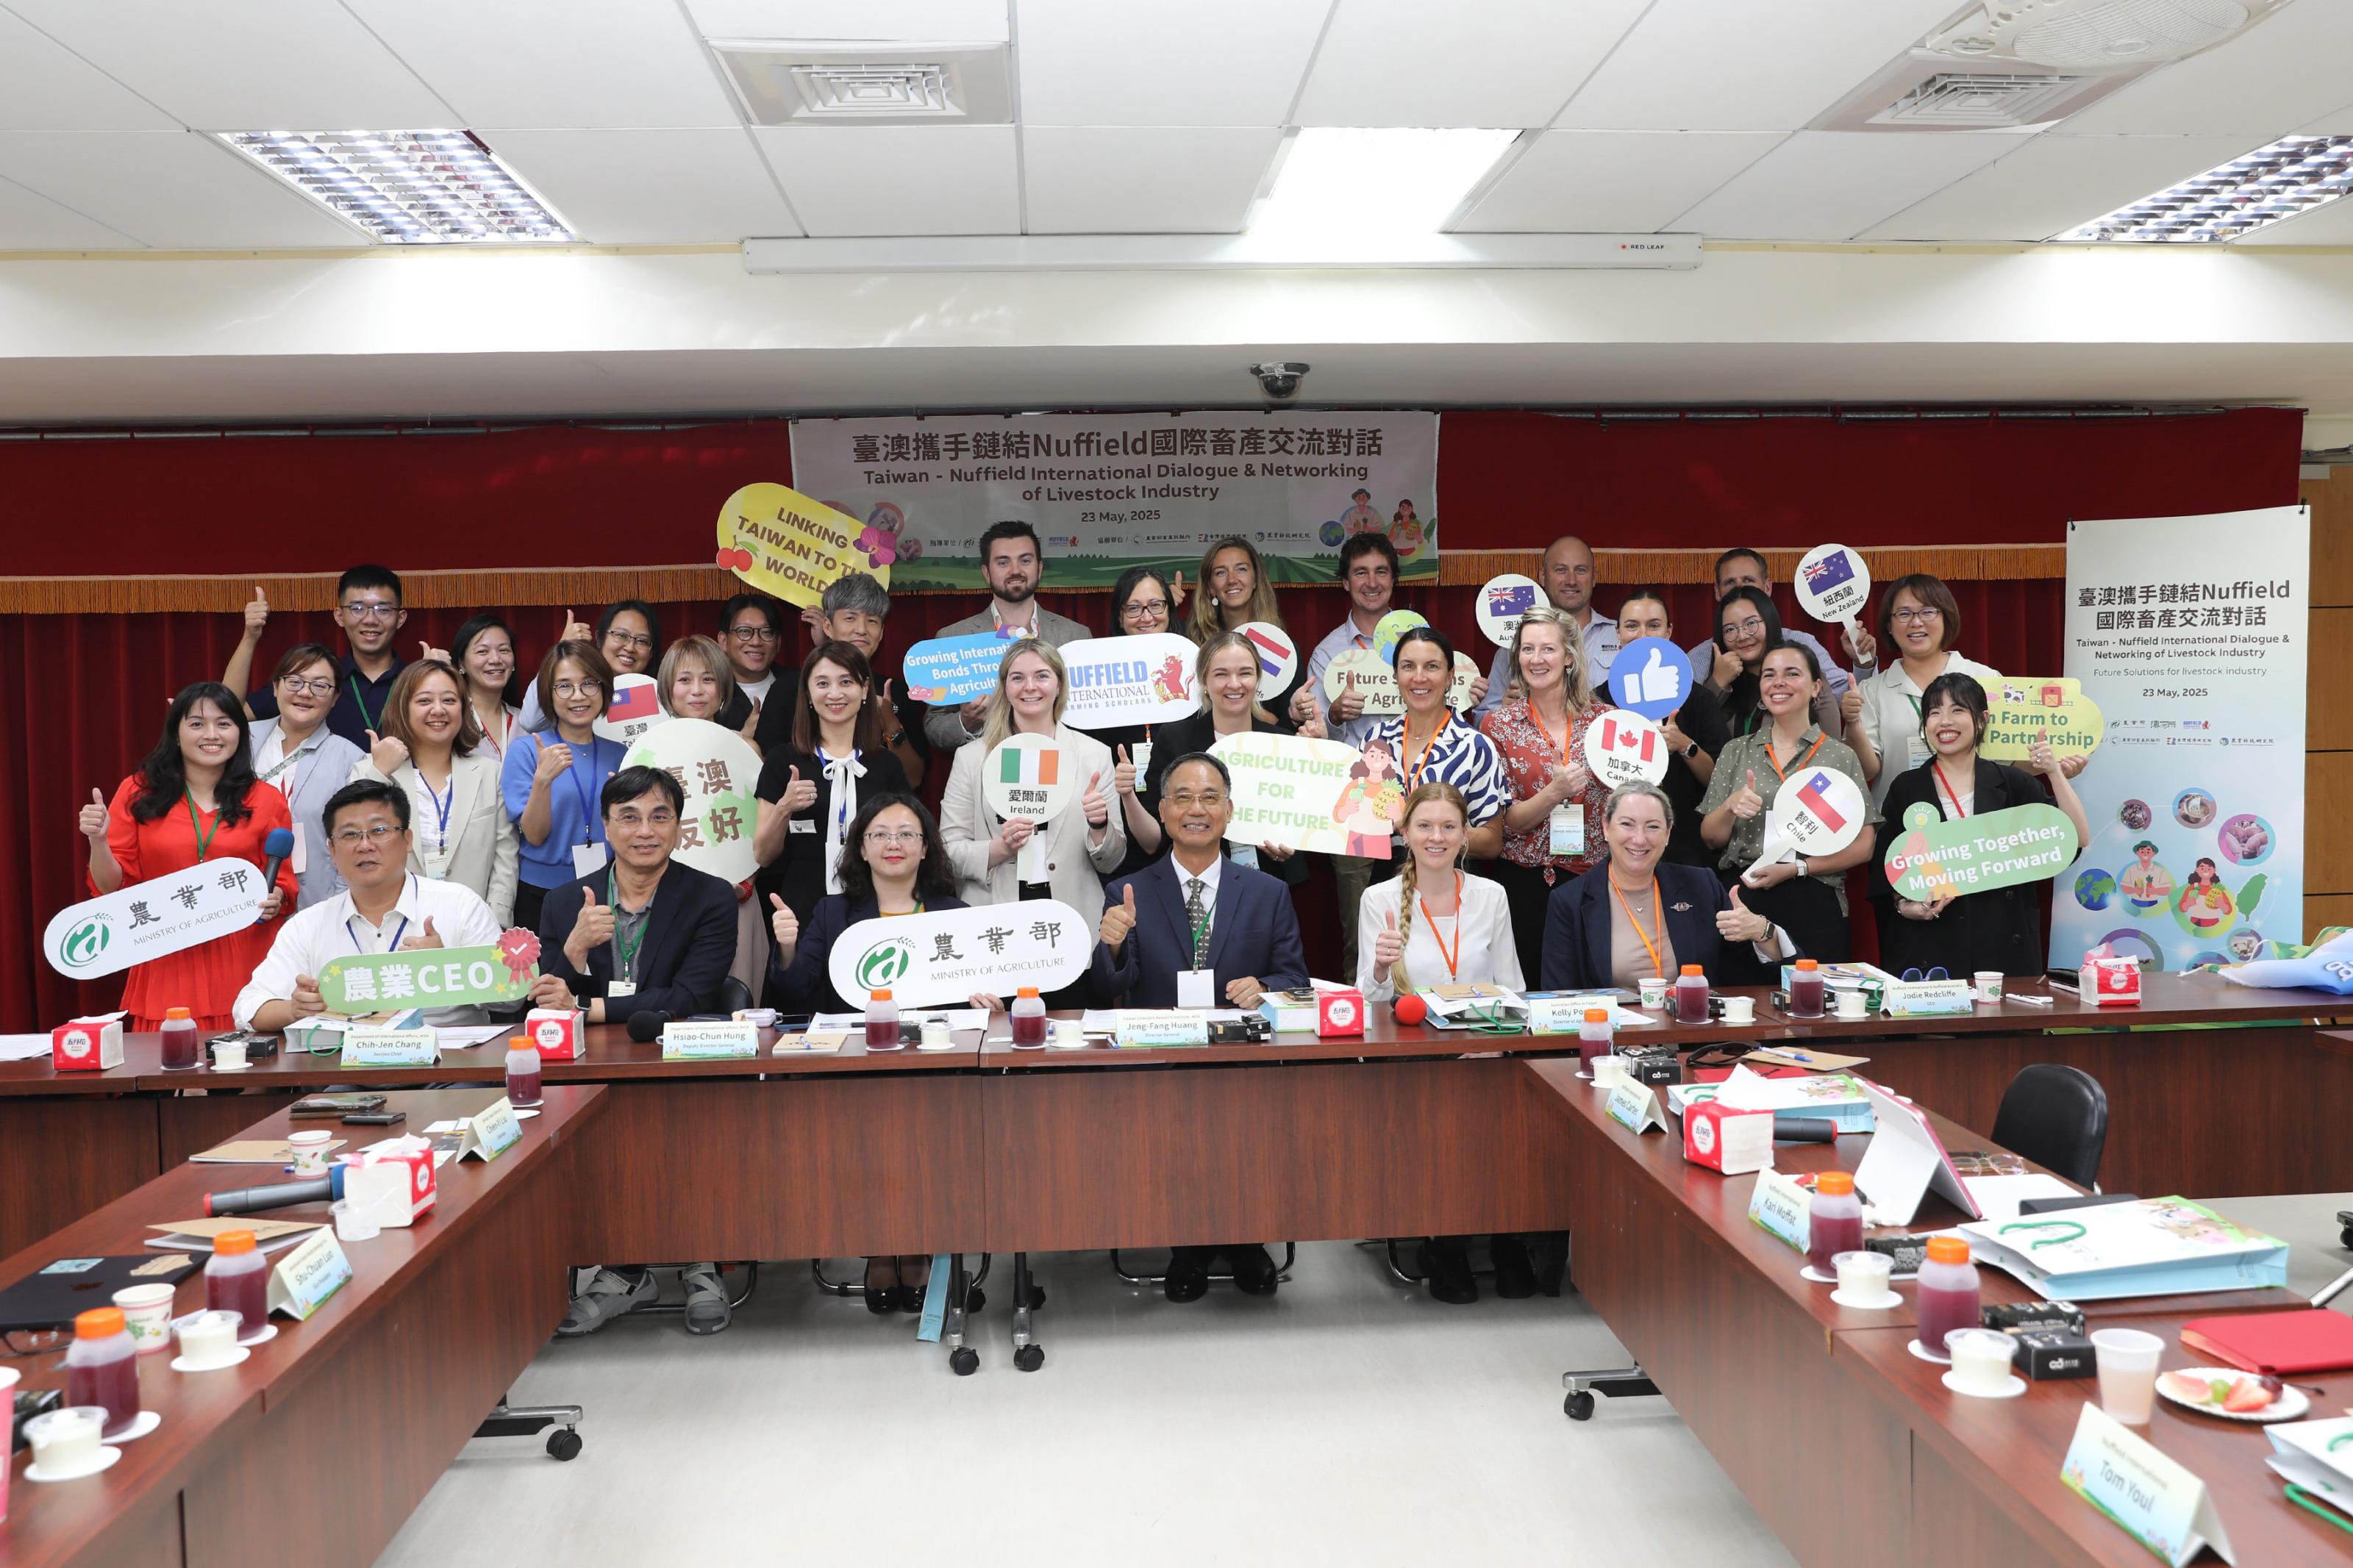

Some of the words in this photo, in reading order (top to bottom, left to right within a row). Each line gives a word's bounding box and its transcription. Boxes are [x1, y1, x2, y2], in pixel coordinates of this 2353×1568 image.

[863, 470, 929, 484] Taiwan
[950, 466, 1026, 482] Nuffield
[1031, 463, 1151, 480] International
[1157, 463, 1238, 480] Dialogue
[1243, 463, 1256, 476] &
[1262, 462, 1368, 480] Networking
[1022, 487, 1041, 501] of
[1047, 485, 1136, 501] Livestock
[1142, 484, 1220, 501] Industry
[1081, 512, 1096, 522] 23
[1099, 511, 1127, 523] May,
[1130, 509, 1161, 520] 2025
[776, 507, 848, 548] LINKING
[738, 515, 811, 560] TAIWAN
[815, 551, 837, 571] TO
[765, 556, 829, 594] WORLD
[1824, 585, 1854, 606] 紐西蘭
[1822, 608, 1837, 619] New
[1838, 595, 1864, 612] Zealand
[2096, 606, 2266, 630] 國際畜產交流對話
[2077, 639, 2109, 647] Taiwan
[2119, 637, 2158, 646] Nuffield
[2161, 635, 2227, 645] International
[2230, 634, 2279, 645] Dialogue
[906, 651, 959, 667] Growing
[2095, 650, 2152, 660] Networking
[2154, 650, 2165, 658] of
[2168, 648, 2217, 658] Livestock
[2219, 648, 2265, 659] Industry
[932, 664, 970, 680] Bonds
[2093, 668, 2121, 676] Future
[2124, 667, 2165, 676] Solutions
[2167, 667, 2179, 676] for
[2182, 667, 2223, 676] livestock
[2226, 667, 2267, 677] industry
[1105, 698, 1151, 708] SCHOLARS
[2142, 689, 2154, 697] 23
[2157, 688, 2180, 698] May,
[2182, 688, 2208, 696] 2025
[2002, 712, 2045, 725] Farm
[2050, 713, 2068, 726] to
[1217, 750, 1346, 778] AGRICULTURE
[1607, 756, 1643, 776] 加拿大
[1008, 790, 1048, 803] 愛爾蘭
[1257, 781, 1295, 799] FOR
[1010, 806, 1045, 815] Ireland
[1231, 806, 1254, 823] HE
[1258, 809, 1329, 830] FUTURE
[1786, 823, 1806, 842] Chile
[1794, 811, 1818, 835] 智利
[1891, 844, 1972, 870] Growing
[1974, 824, 2065, 853] Together,
[1908, 867, 1979, 891] Moving
[1980, 845, 2063, 876] Forward
[129, 869, 248, 930] 農業部
[133, 925, 177, 946] MINISTRY
[179, 920, 193, 931] OF
[195, 898, 258, 926] AGRICULTURE
[929, 921, 1061, 962] 農業部
[930, 967, 979, 981] MINISTRY
[980, 965, 994, 975] OF
[996, 957, 1065, 973] AGRICULTURE
[343, 962, 493, 1002] 農業CEO
[1924, 990, 1956, 998] Redcliffe
[1552, 1009, 1571, 1017] Kelly
[724, 1032, 746, 1041] Hung
[1127, 1023, 1169, 1031] Jeng-Fang
[1171, 1022, 1198, 1030] Huang
[357, 1041, 393, 1049] Chih-Jen
[395, 1041, 421, 1049] Chang
[1776, 1205, 1796, 1226] Moffat
[2100, 1459, 2124, 1491] Tom
[2127, 1480, 2154, 1514] Youl
